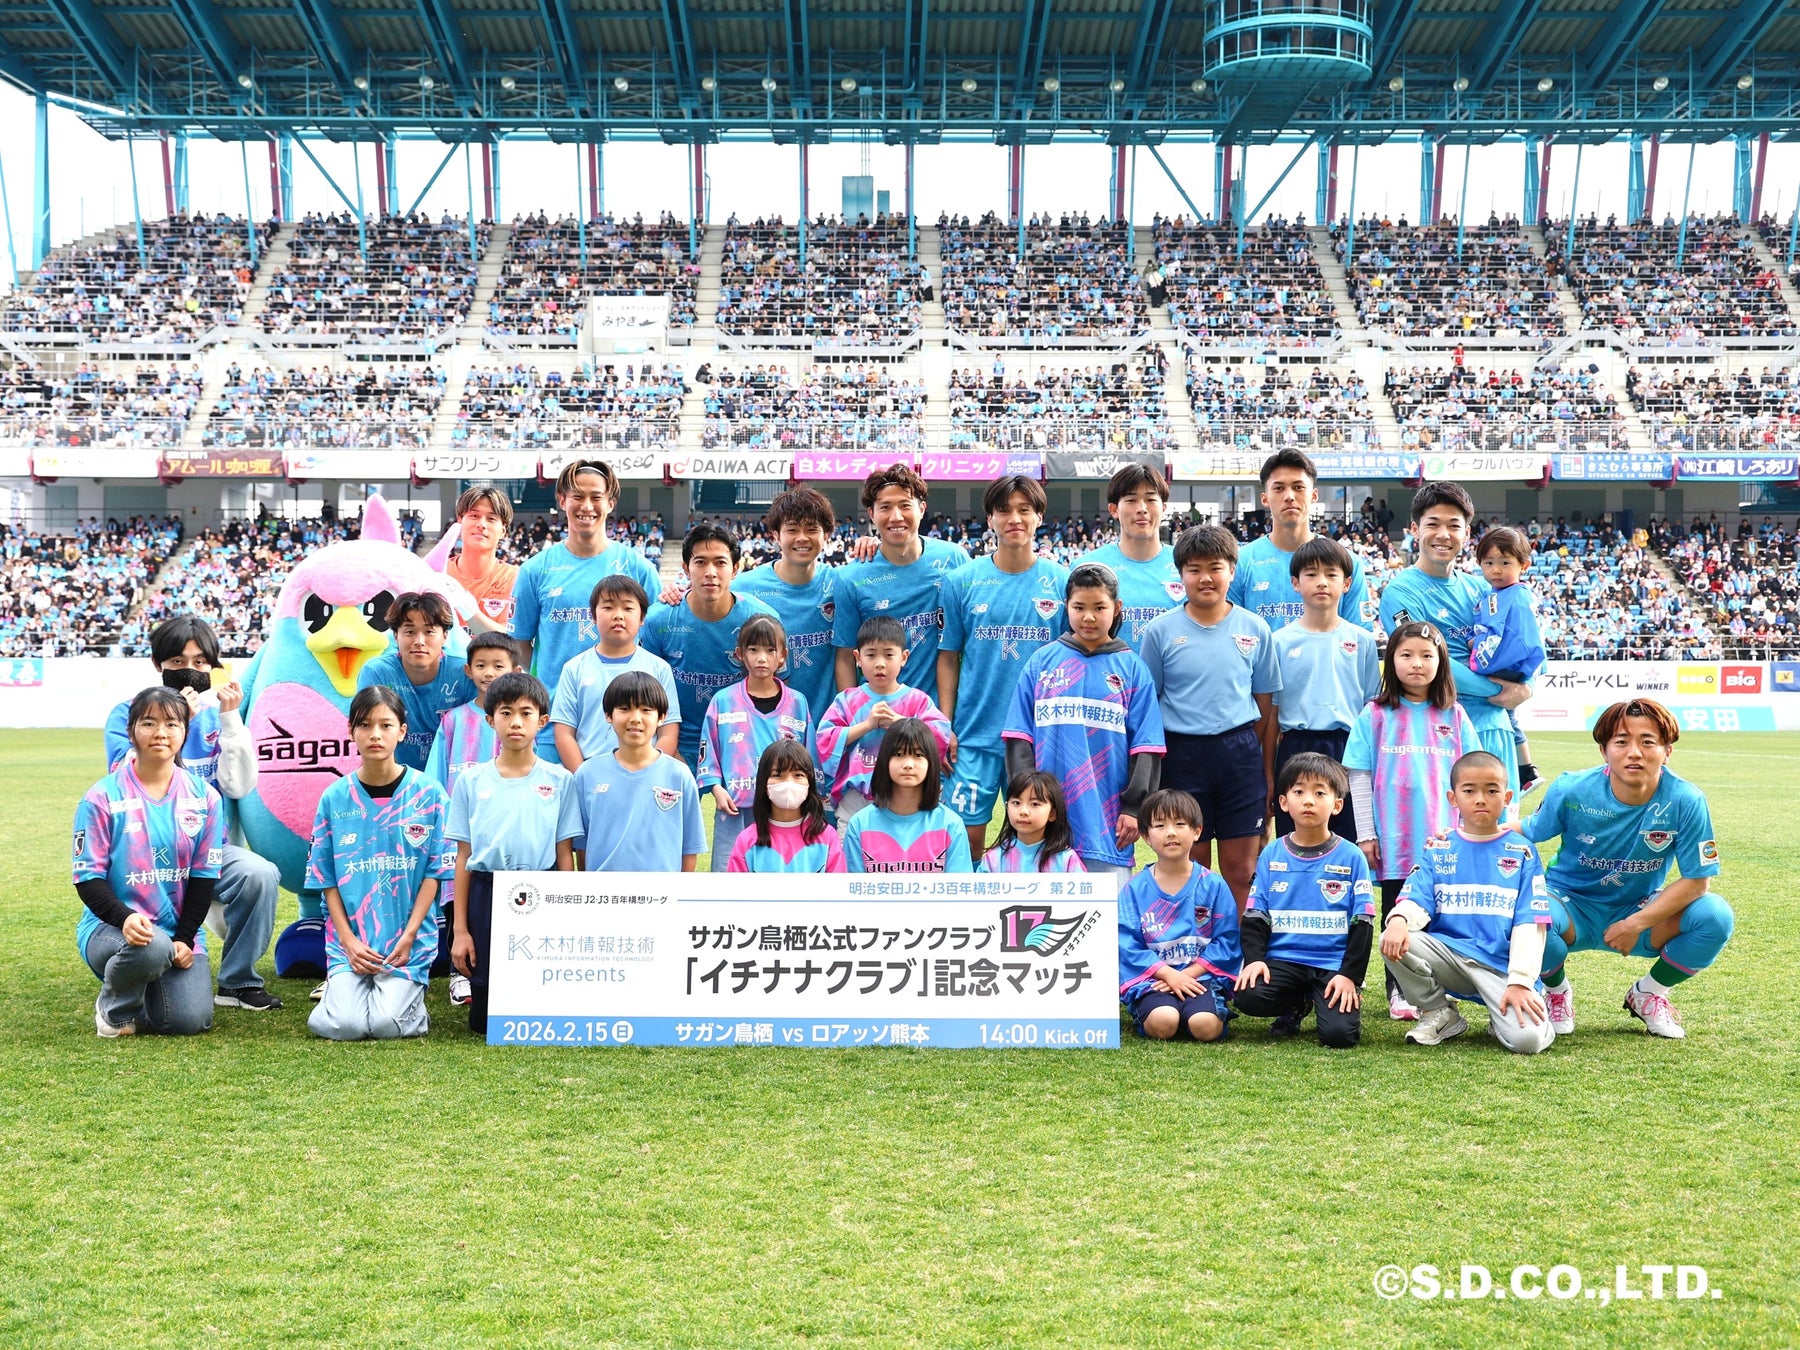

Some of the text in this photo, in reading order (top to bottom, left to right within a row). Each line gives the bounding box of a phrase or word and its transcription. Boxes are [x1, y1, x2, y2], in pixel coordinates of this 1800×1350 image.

[424, 456, 500, 472] サニクリーン
[692, 459, 788, 474] DAIWA ACT
[924, 459, 1001, 474] クリニック
[1448, 457, 1538, 471] イーグルハウス
[975, 625, 1051, 641] 木村情報技術
[1039, 669, 1065, 681] Full
[1544, 671, 1629, 688] スポーツくじ
[1636, 682, 1670, 691] WINNER
[951, 781, 978, 813] 41
[1578, 803, 1618, 819] X-mobile
[344, 854, 419, 876] 木村情報技術
[1444, 852, 1458, 864] ARE
[1577, 852, 1664, 873] 木村情報技術
[1050, 881, 1093, 896] 第2節
[545, 894, 583, 904] 明治安田
[611, 895, 668, 905] 百年構想リーグ
[1275, 915, 1346, 929] 木村情報技術
[537, 935, 656, 954] 木村情報技術
[688, 924, 996, 952] サガン鳥栖公式ファンクラブ
[542, 967, 626, 986] presents
[687, 957, 1092, 997] 「イチナナクラブ」記念マッチ
[503, 1021, 609, 1042] 2026.2.15
[675, 1022, 774, 1043] サガン鳥栖
[812, 1023, 930, 1043] ロアッソ熊本
[979, 1024, 1038, 1044] 14:00
[1045, 1030, 1079, 1044] Kick
[1084, 1030, 1108, 1044] Off
